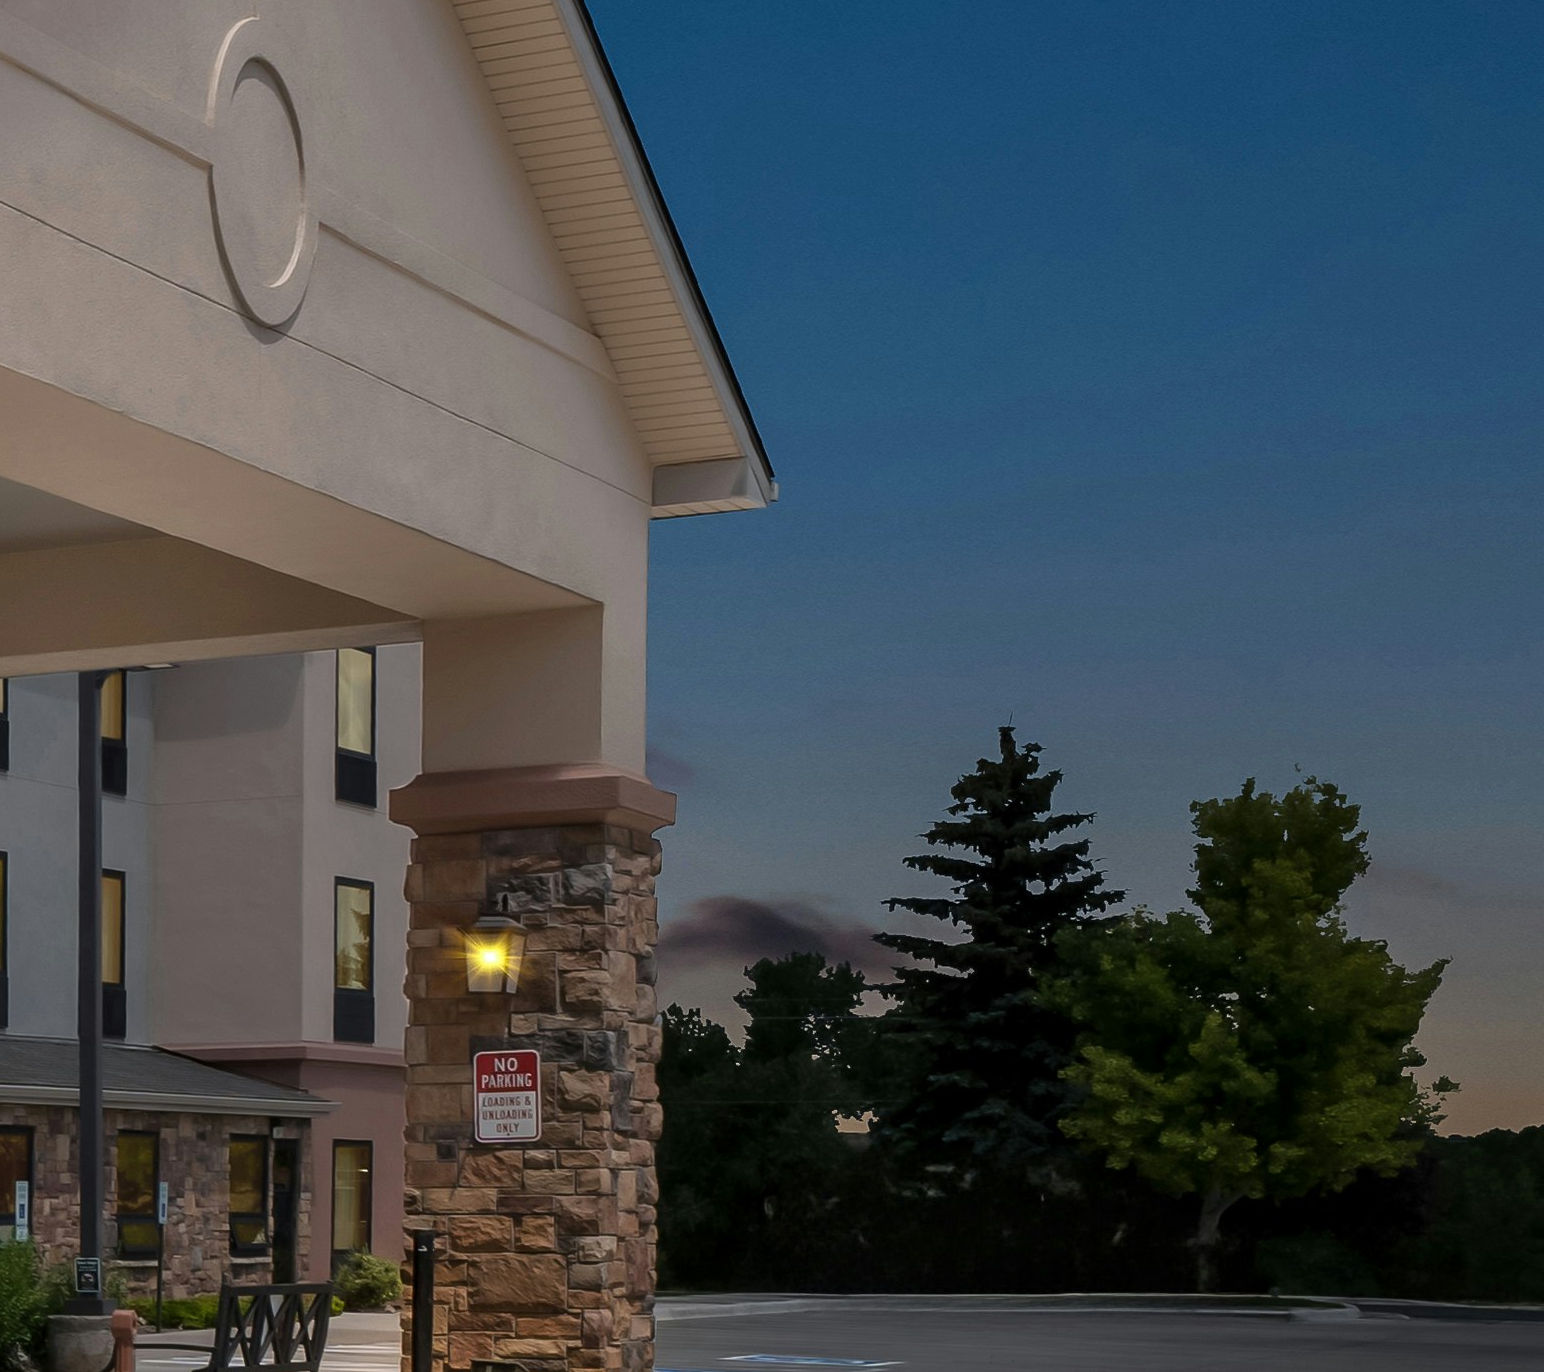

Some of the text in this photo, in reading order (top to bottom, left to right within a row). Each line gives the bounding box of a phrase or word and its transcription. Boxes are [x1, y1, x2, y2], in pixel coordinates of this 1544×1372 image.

[494, 1057, 518, 1072] NO
[481, 1073, 532, 1089] PARKING
[482, 1095, 531, 1107] LOADING &
[482, 1109, 533, 1121] UNLOADING
[496, 1123, 520, 1133] ONLY
